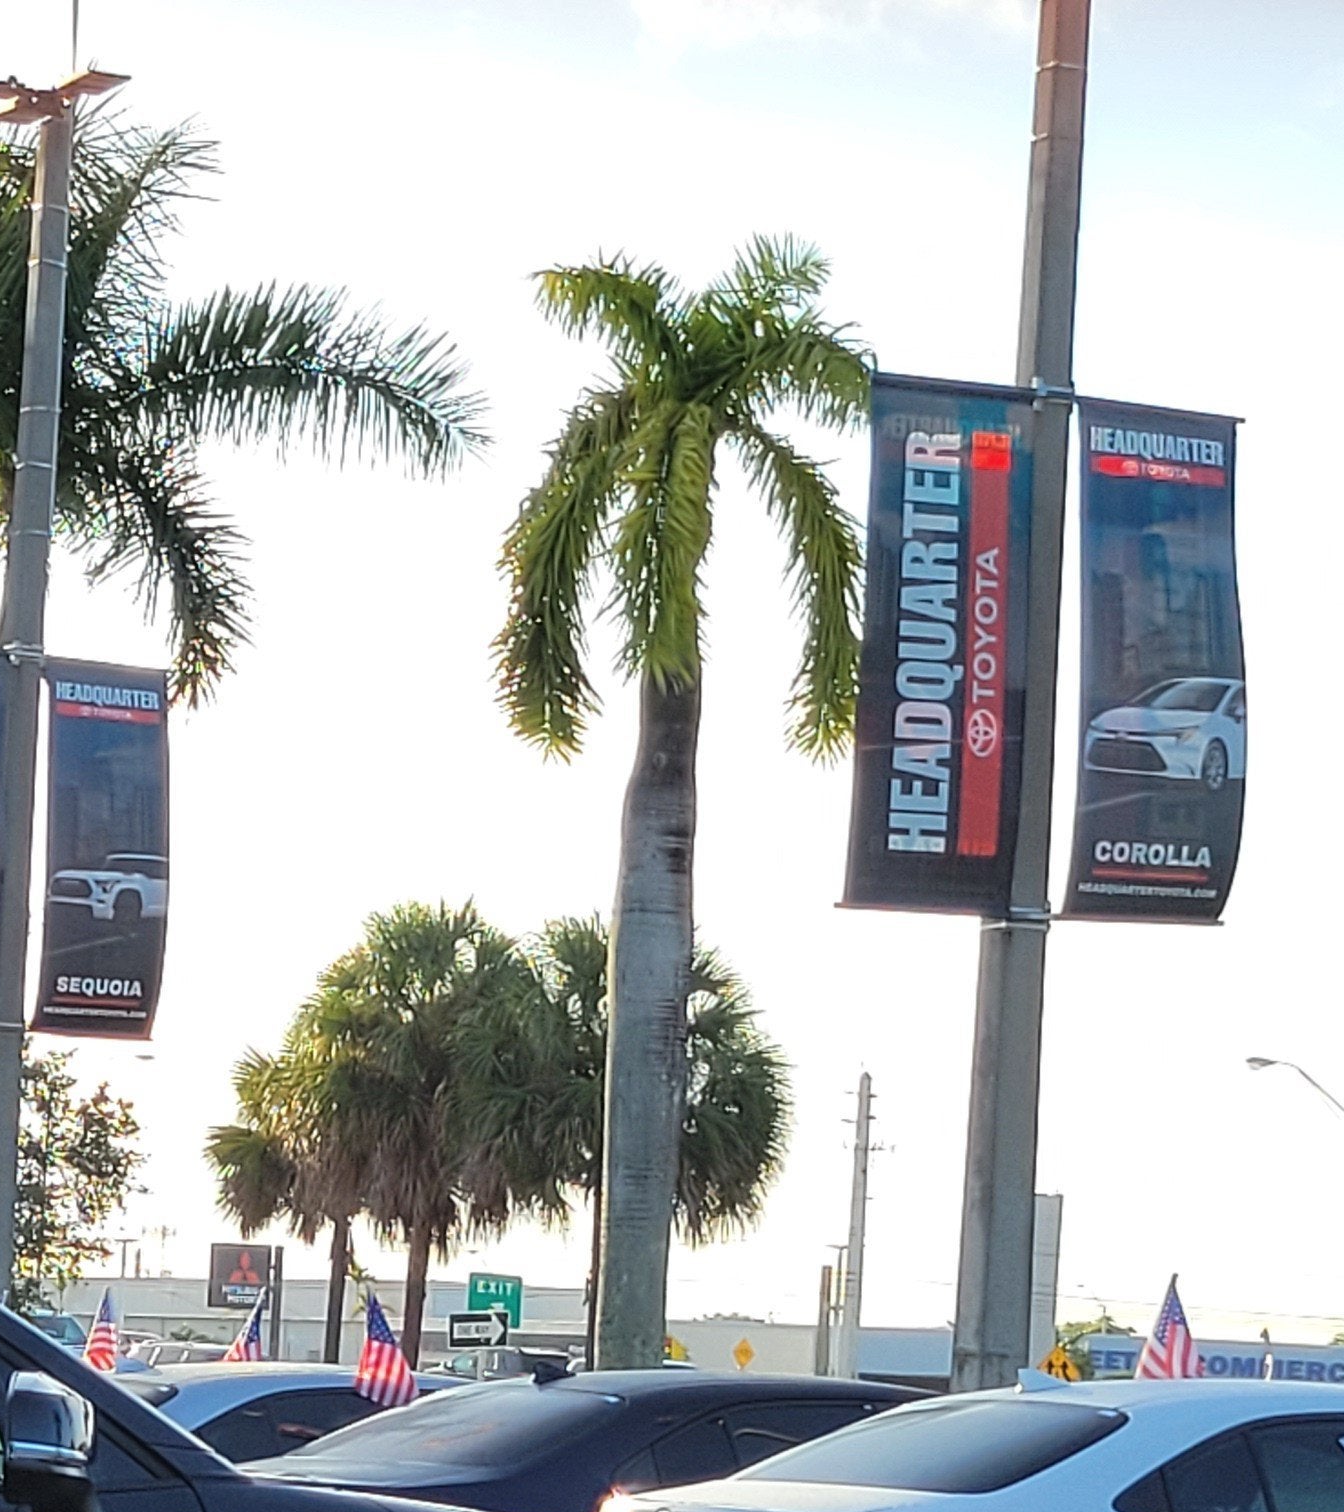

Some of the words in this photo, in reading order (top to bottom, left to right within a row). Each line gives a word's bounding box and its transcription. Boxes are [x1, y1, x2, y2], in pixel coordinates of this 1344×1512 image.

[1090, 426, 1224, 466] HEADQUARTER
[1141, 463, 1191, 481] TOYOTA
[971, 546, 1001, 704] TOYOTA
[887, 431, 964, 854] HEADQUARTER
[55, 681, 160, 711] HEADQUARTER
[1094, 840, 1212, 868] COROLLA
[56, 976, 143, 997] SEQUOIA
[477, 1280, 513, 1297] EXIT
